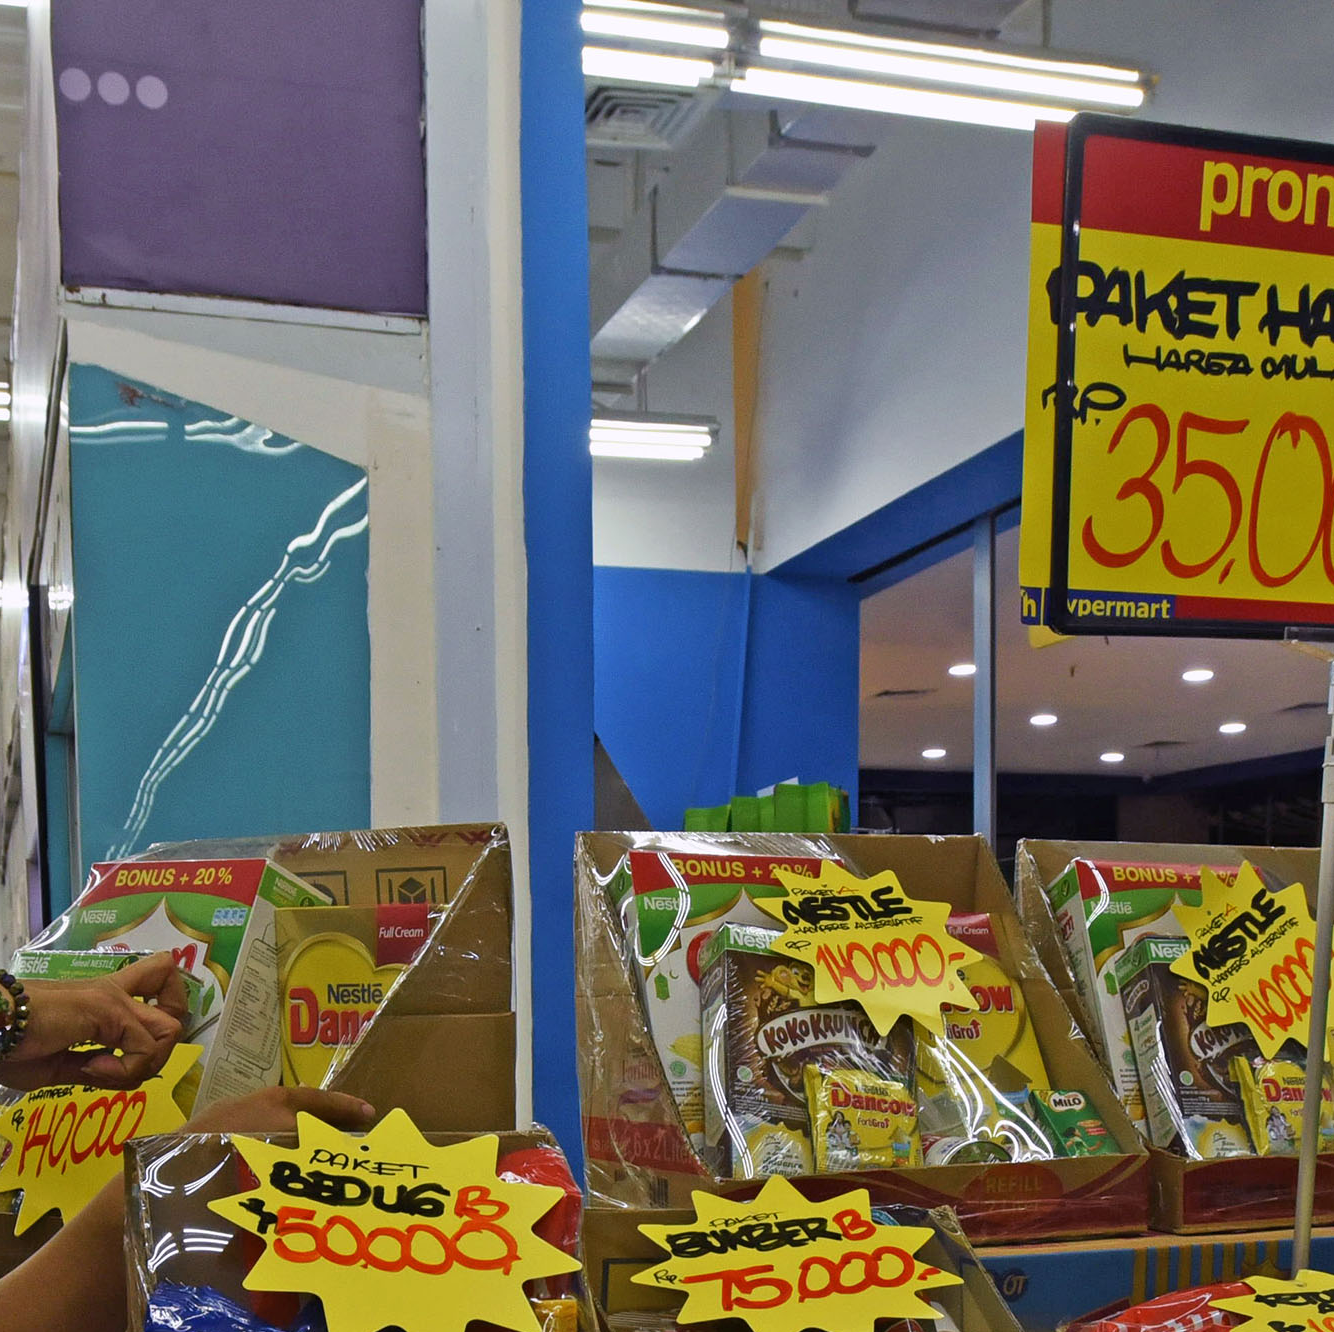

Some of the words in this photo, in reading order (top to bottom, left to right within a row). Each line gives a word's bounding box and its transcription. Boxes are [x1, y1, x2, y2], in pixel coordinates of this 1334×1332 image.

[1046, 261, 1259, 341] PAKET
[1067, 597, 1171, 621] ypermart
[115, 868, 175, 887] BONUS
[673, 858, 745, 878] BONUS
[1112, 866, 1178, 883] BONUS
[781, 885, 913, 926] NESTLE
[378, 926, 395, 939] Full
[394, 926, 425, 939] Cream
[1192, 888, 1287, 980] NESTLE
[327, 983, 383, 1005] Nestlé
[1052, 1096, 1082, 1109] MILO
[309, 1149, 431, 1179] PAKET
[270, 1162, 451, 1217] BEDUG
[455, 1185, 511, 1219] B
[986, 1175, 1041, 1193] REFILL
[832, 1208, 877, 1241] B
